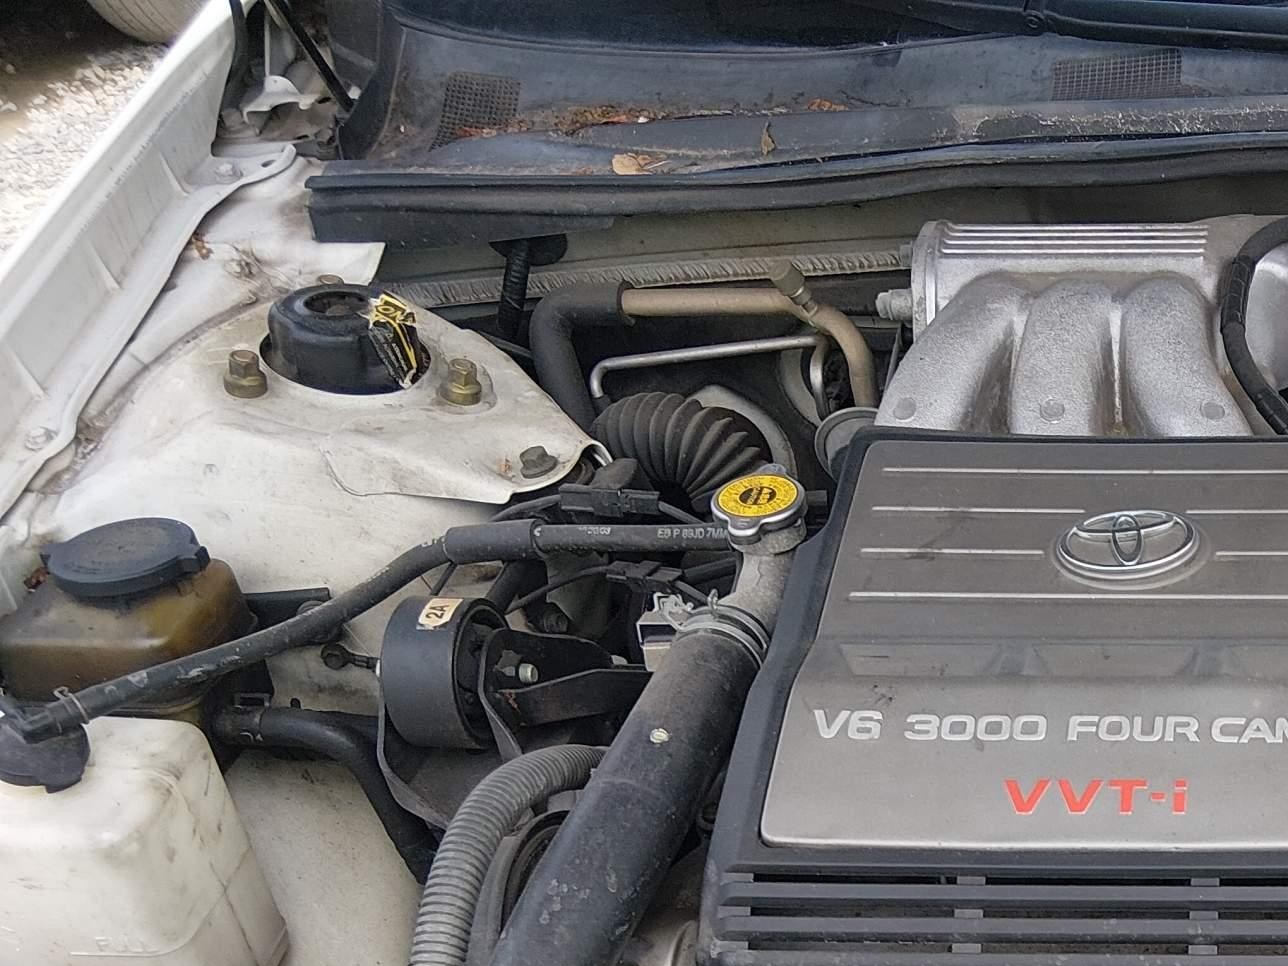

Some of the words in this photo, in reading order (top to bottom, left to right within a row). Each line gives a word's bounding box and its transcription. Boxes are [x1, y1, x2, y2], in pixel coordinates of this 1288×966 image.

[813, 709, 883, 739] V6
[904, 714, 1047, 741] 3000
[1067, 715, 1199, 741] FOUR
[1005, 779, 1188, 815] VVT-i
